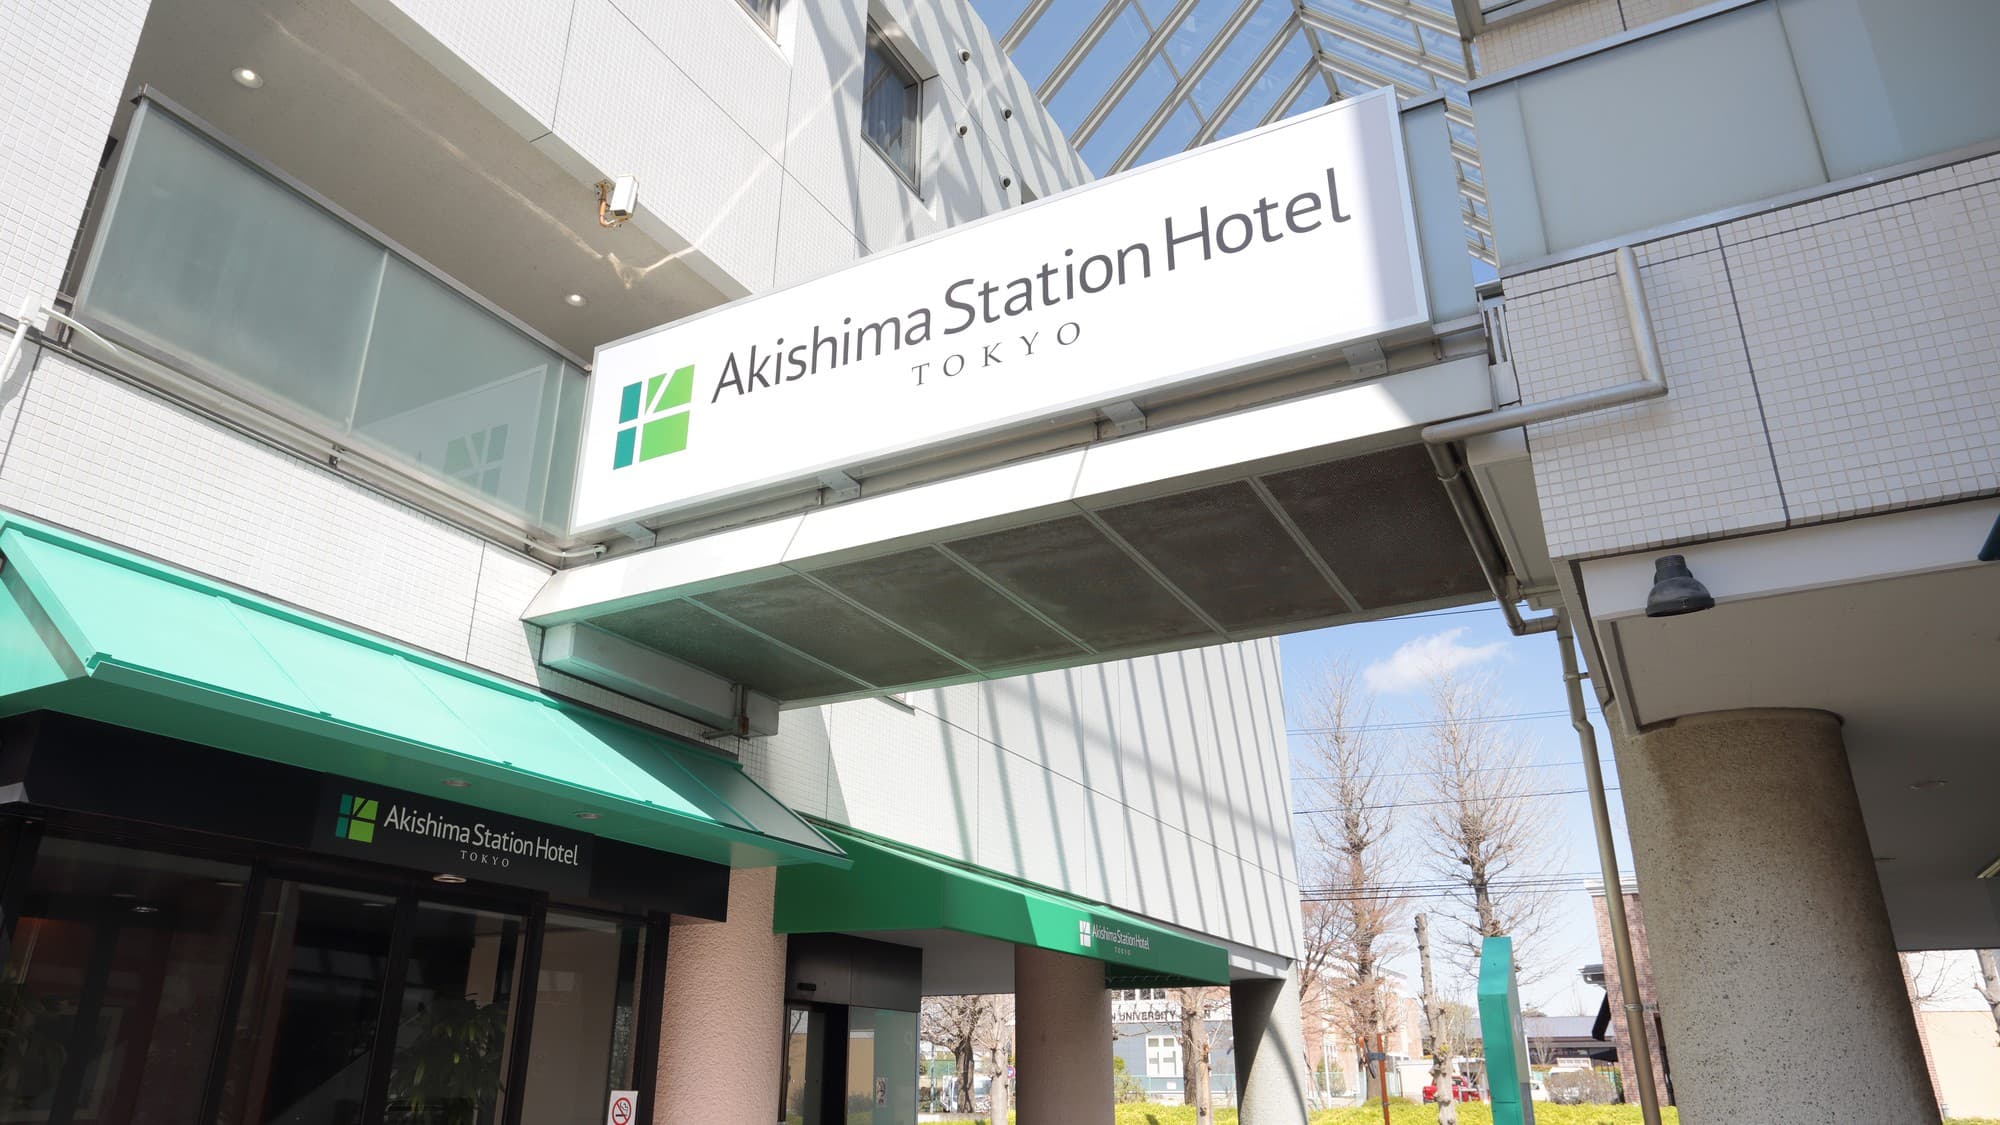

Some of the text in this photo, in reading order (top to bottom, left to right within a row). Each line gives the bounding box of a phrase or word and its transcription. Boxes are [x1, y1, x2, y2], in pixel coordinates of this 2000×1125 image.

[711, 167, 1351, 405] Akishima Station Hotel
[911, 320, 1082, 387] TOKYO
[383, 804, 579, 866] Akishima Station Hotel
[459, 850, 510, 868] TOKYO
[1116, 929, 1136, 947] Station
[1119, 1010, 1176, 1021] UNIVERSITY
